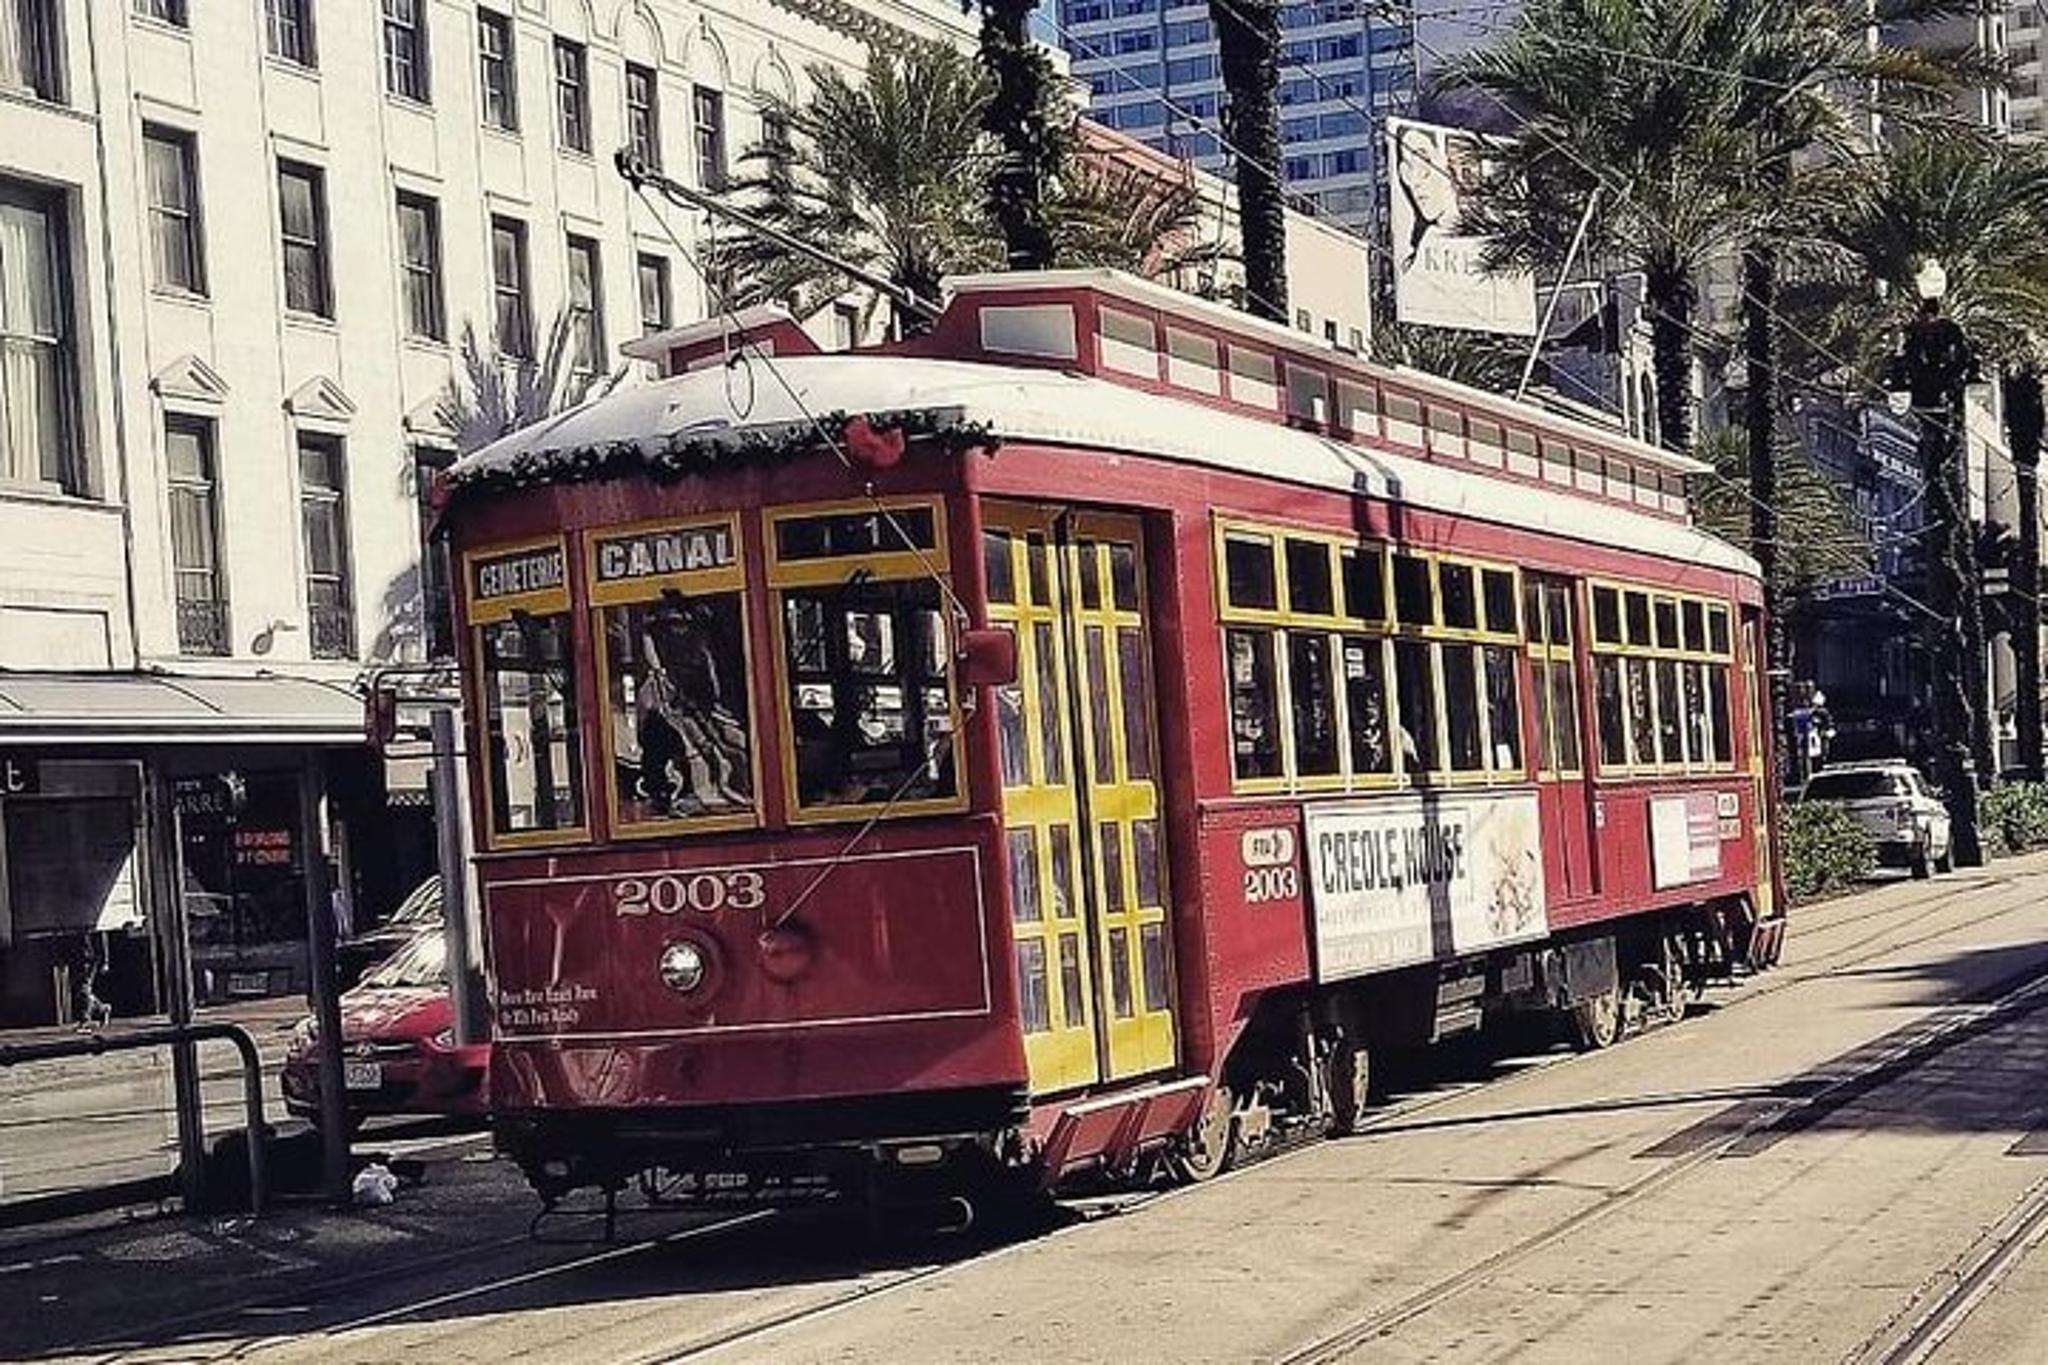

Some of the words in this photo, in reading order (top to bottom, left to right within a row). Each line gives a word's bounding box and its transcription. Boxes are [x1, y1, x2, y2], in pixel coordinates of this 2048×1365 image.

[479, 553, 563, 597] CEMETERIE
[602, 533, 735, 579] CANAL
[1319, 829, 1400, 893] CREOLE
[1402, 823, 1465, 886] HOUSE
[614, 872, 766, 916] 2003
[1245, 866, 1298, 902] 2003
